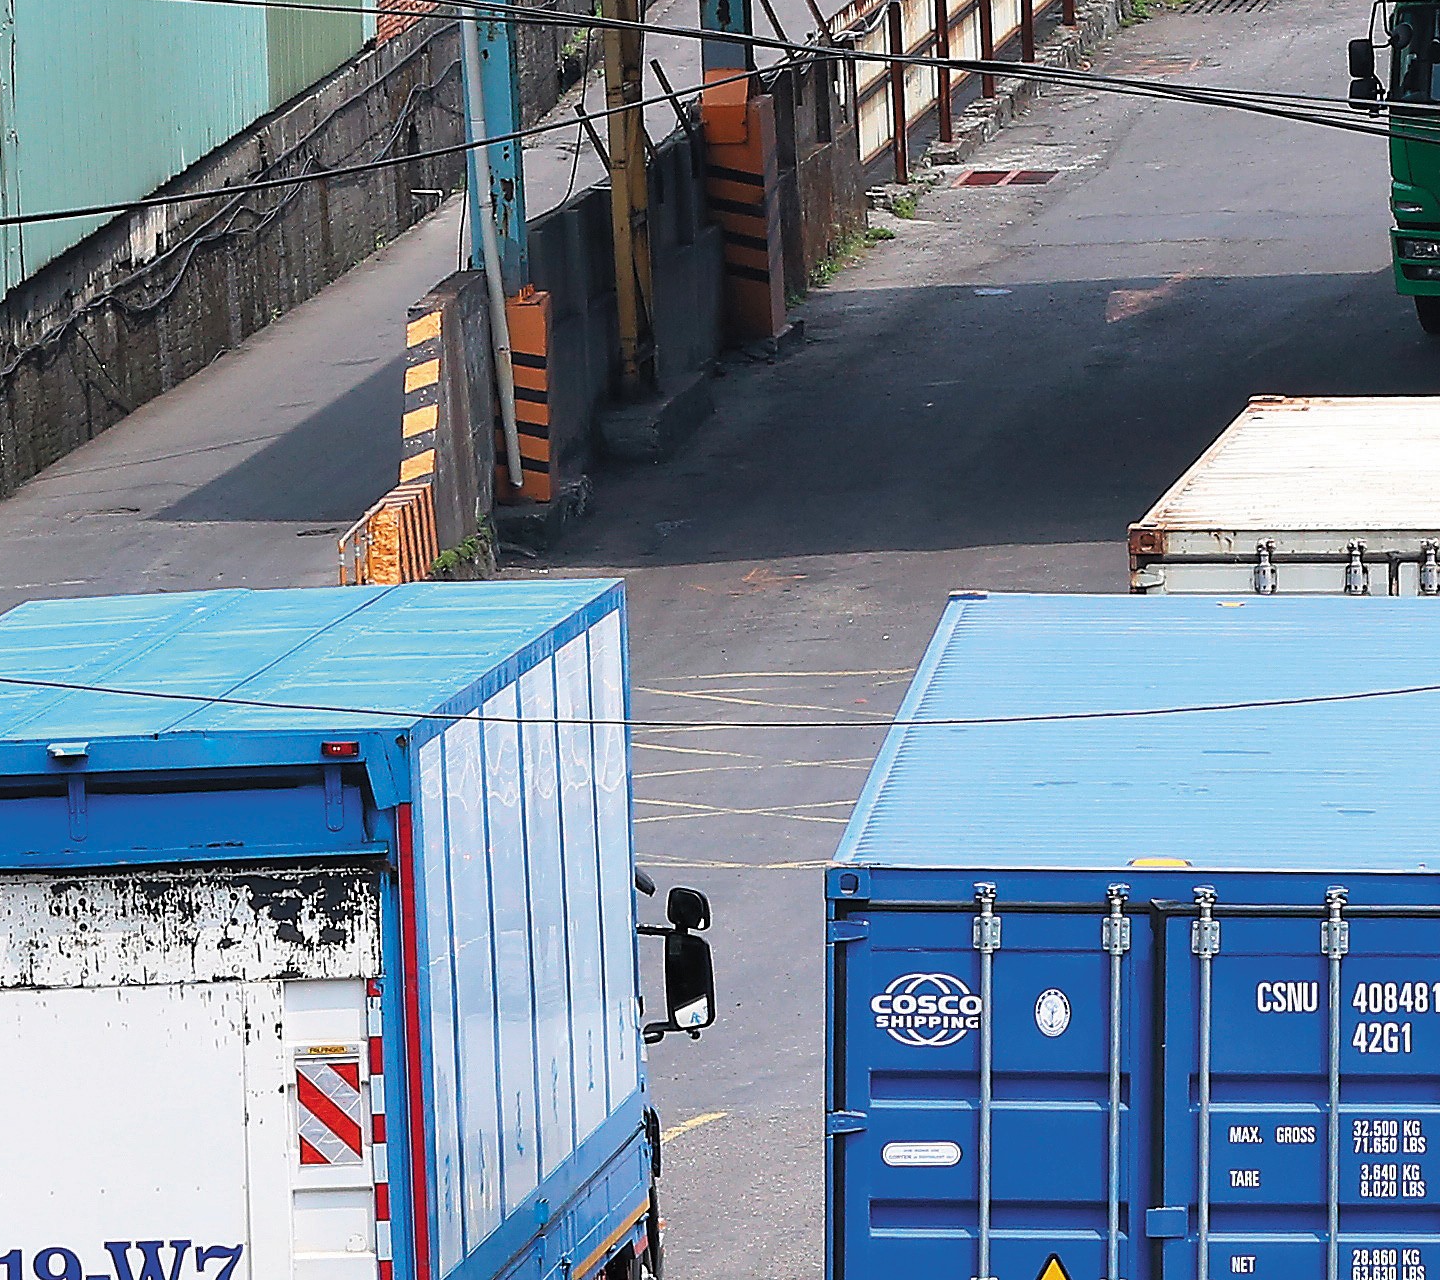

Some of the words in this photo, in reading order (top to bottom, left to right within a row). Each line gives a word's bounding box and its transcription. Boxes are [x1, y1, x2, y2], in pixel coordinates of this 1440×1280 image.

[871, 995, 982, 1014] COSCO
[1257, 982, 1318, 1013] CSNU
[876, 1015, 979, 1028] SHIPPING
[1352, 1023, 1412, 1053] 42G1
[1230, 1127, 1262, 1144] MAX.
[1276, 1127, 1316, 1143] GROSS
[1353, 1121, 1398, 1138] 32.500
[1403, 1121, 1421, 1137] KG
[1353, 1137, 1398, 1154] 71.650
[1403, 1137, 1426, 1153] LBS
[1230, 1171, 1260, 1187] TARE
[1361, 1164, 1398, 1181] 3.640
[1403, 1164, 1420, 1180] KG
[1361, 1181, 1398, 1197] 8.020
[1403, 1180, 1426, 1196] LBS
[1232, 1257, 1255, 1273] NET
[1353, 1249, 1398, 1266] 28.860
[1403, 1249, 1421, 1265] KG
